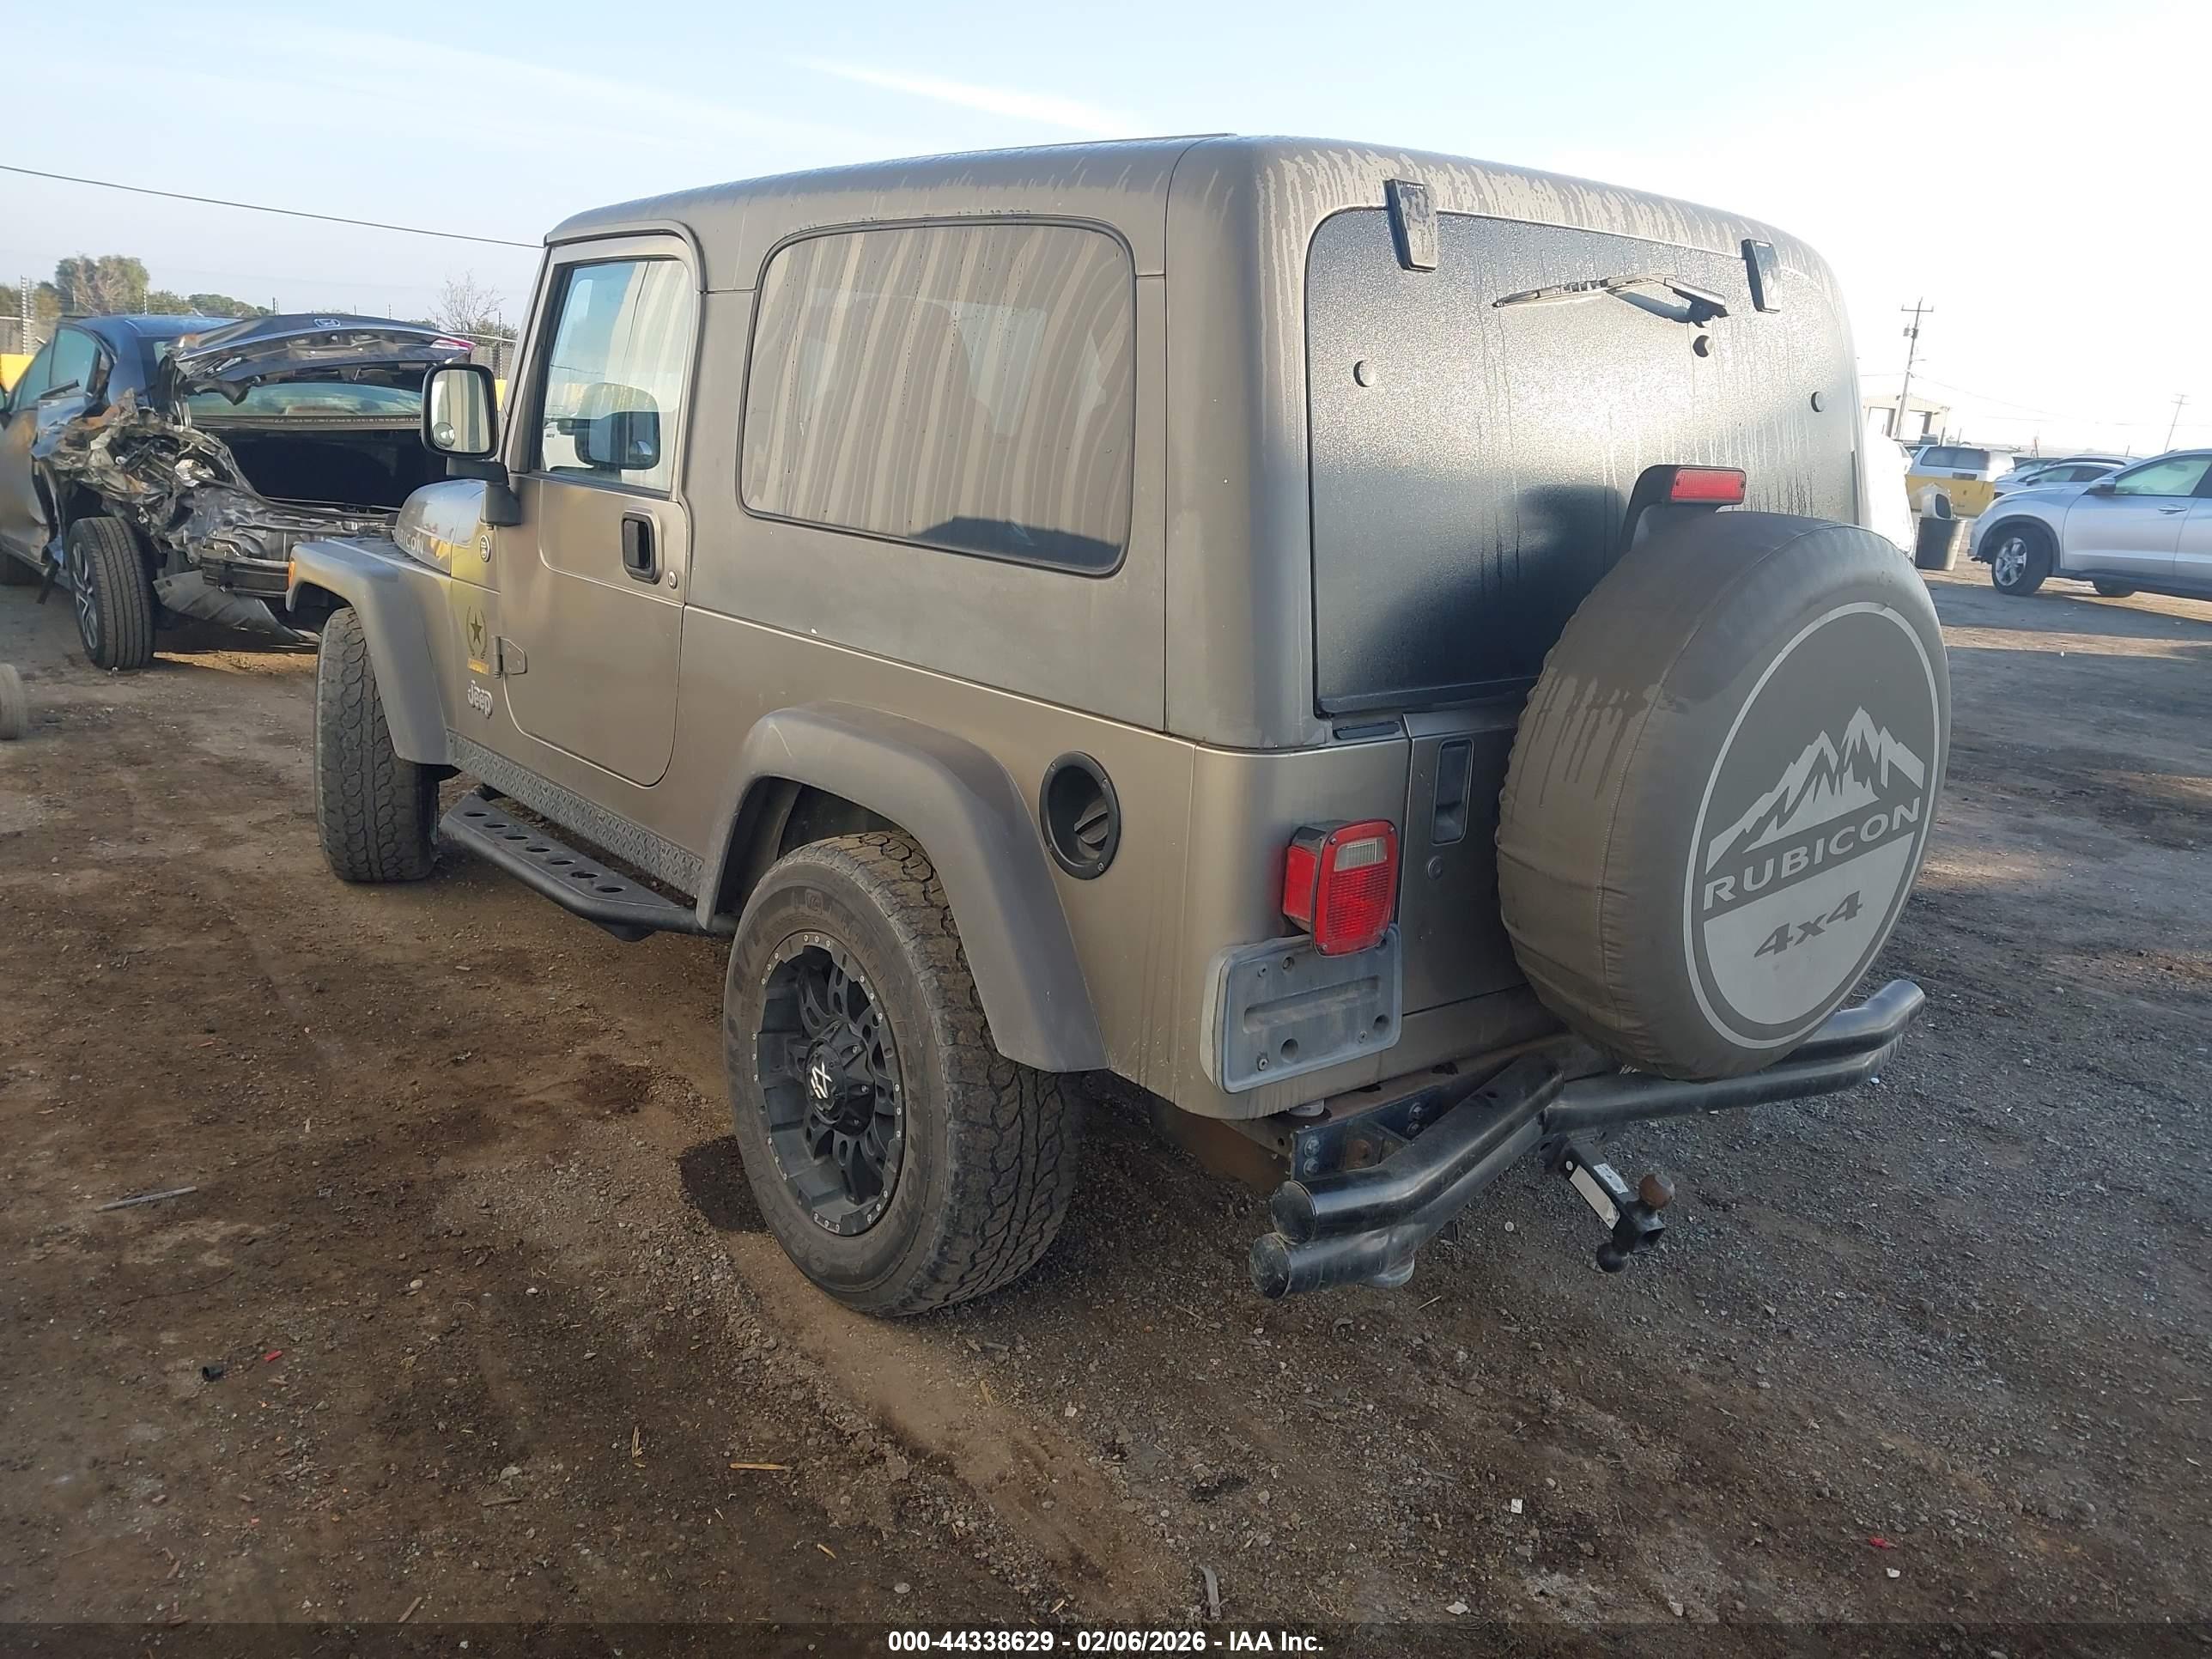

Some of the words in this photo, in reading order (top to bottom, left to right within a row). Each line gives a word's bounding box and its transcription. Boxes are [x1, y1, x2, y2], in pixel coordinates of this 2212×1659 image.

[468, 680, 493, 717] Jeep
[1703, 797, 1921, 910] RUBICON
[1753, 890, 1863, 958] 4x4
